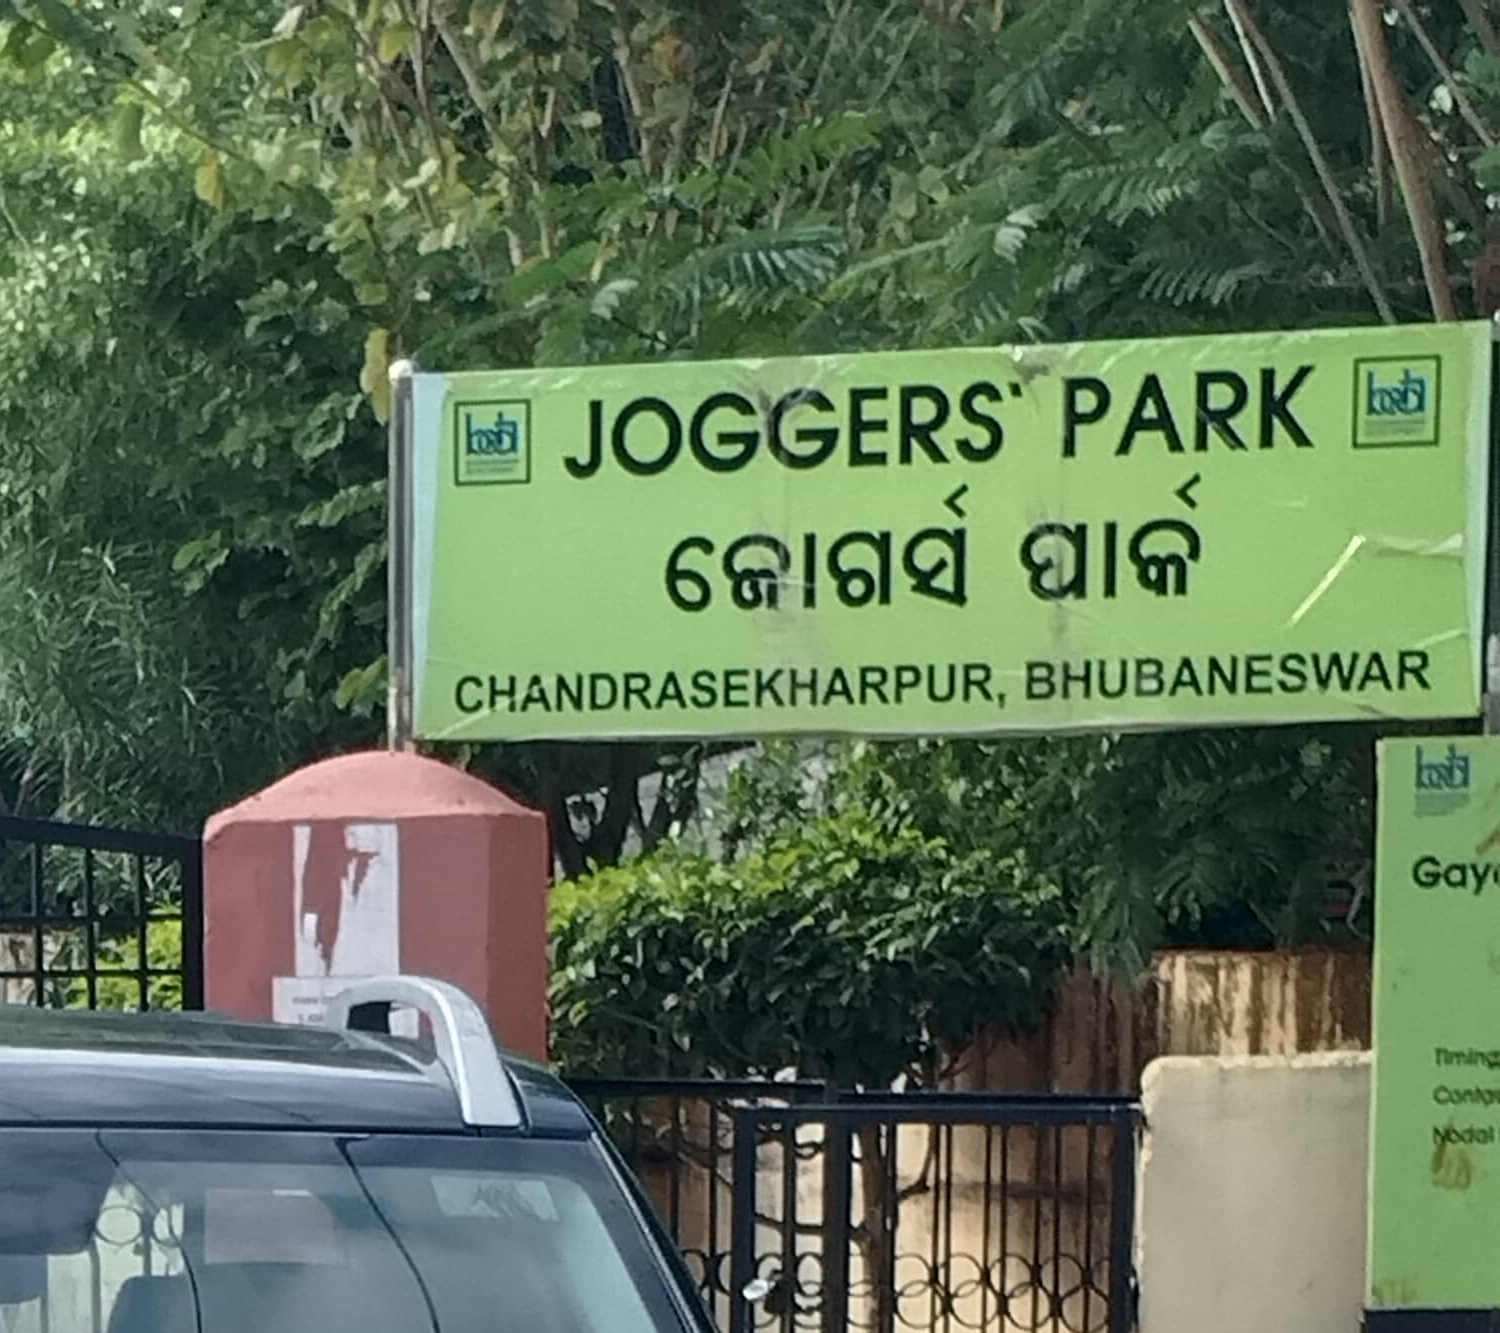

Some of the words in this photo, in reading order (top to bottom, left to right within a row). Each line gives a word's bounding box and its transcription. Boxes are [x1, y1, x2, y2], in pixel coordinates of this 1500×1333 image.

[1062, 364, 1316, 459] PARK
[454, 662, 1006, 714] CHANDRASEKHARPUR,
[1025, 648, 1431, 701] BHUBANESWAR
